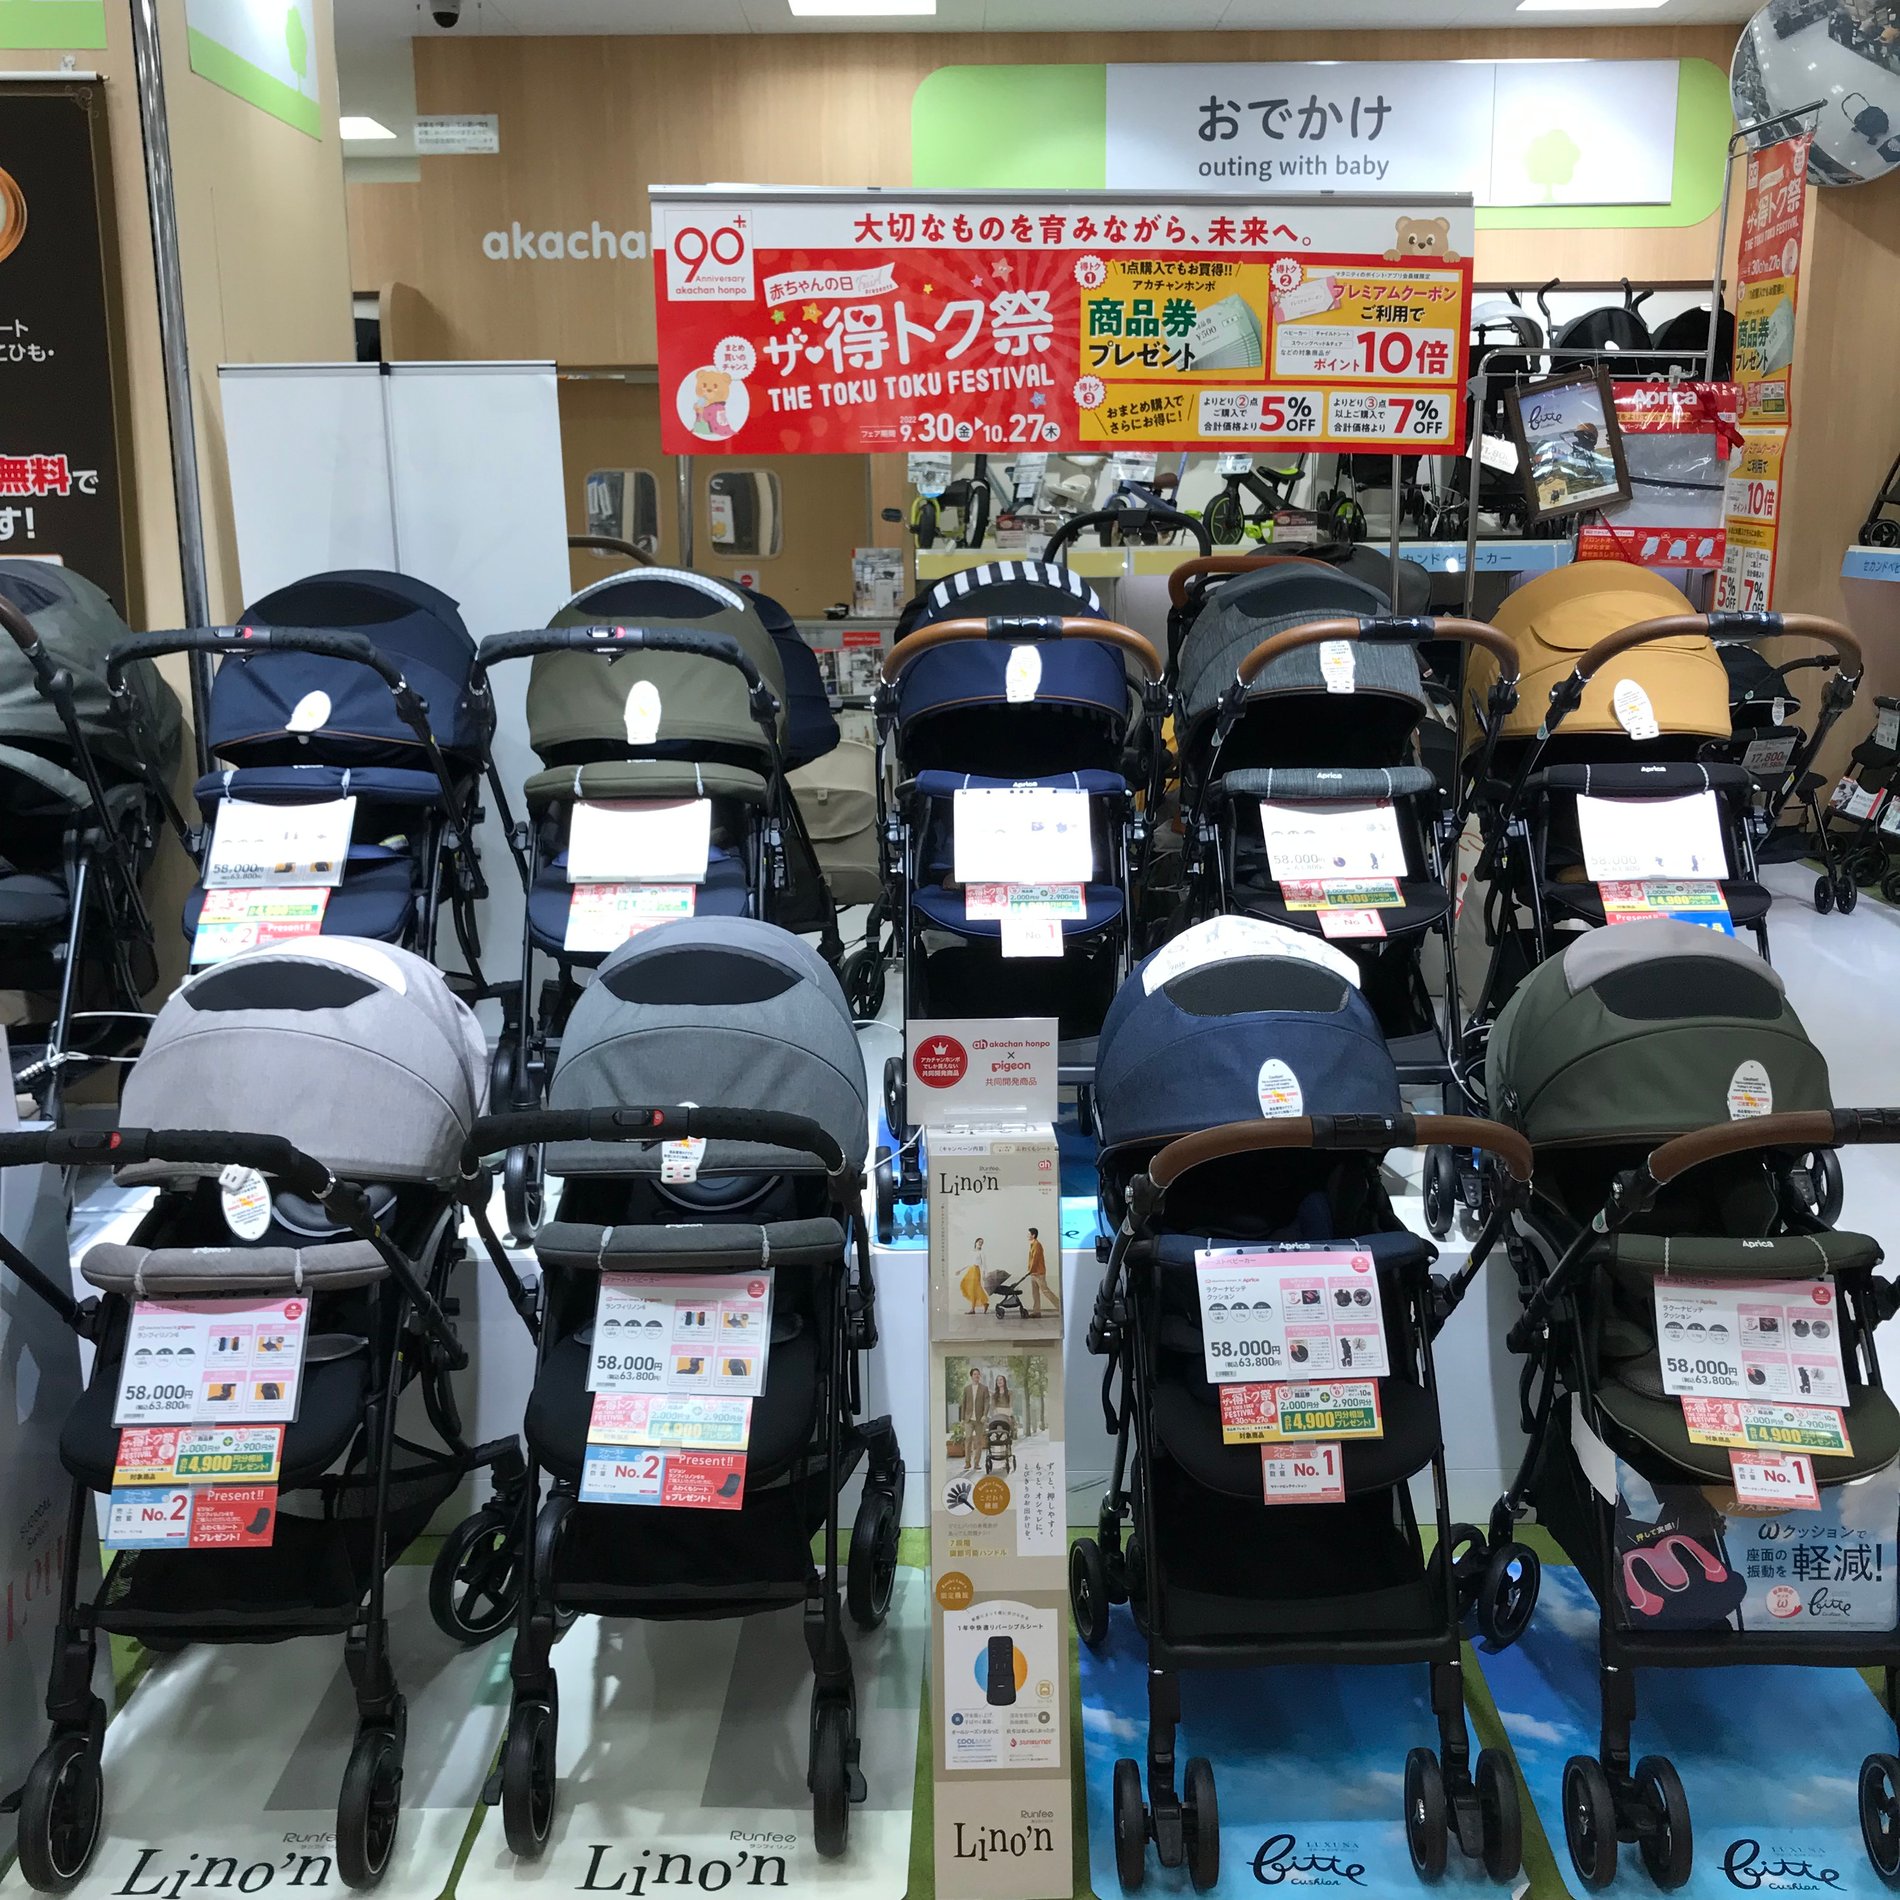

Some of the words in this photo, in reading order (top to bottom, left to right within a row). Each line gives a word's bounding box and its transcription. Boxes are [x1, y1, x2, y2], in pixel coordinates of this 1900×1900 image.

[1198, 95, 1392, 142] おでかけ
[1199, 155, 1273, 182] outing
[1279, 154, 1327, 176] with
[1336, 154, 1390, 181] baby
[854, 213, 1312, 247] 大切なものを育みながら、未来へ。
[482, 220, 648, 260] akacha
[1080, 262, 1101, 271] 得トク
[1120, 262, 1233, 277] 1点購入でもお買得!!
[1276, 264, 1298, 274] 得トク
[695, 275, 745, 284] Anniversary
[769, 276, 854, 301] 赤ちゃんの日
[1132, 280, 1216, 292] アカチャンホンポ
[676, 286, 713, 295] akachan
[717, 286, 747, 297] honpo
[1333, 283, 1457, 302] プレミアムクーポン
[1087, 297, 1198, 338] 商品券
[1361, 305, 1425, 323] ご利用で
[1738, 316, 1769, 348] 商品券
[1089, 340, 1196, 372] プレゼント
[1314, 358, 1360, 372] ポイント
[1357, 331, 1449, 375] 10倍
[768, 388, 812, 412] THE
[819, 382, 877, 405] TOKU
[887, 376, 941, 400] TOKU
[948, 363, 1055, 395] FESTIVAL
[1079, 383, 1100, 392] 得トク
[1106, 395, 1185, 419] おまとめ購入で
[1633, 388, 1698, 408] Aprica
[1213, 408, 1247, 418] ご購入で
[1258, 396, 1312, 432] 5%
[1286, 419, 1316, 432] OFF
[1335, 410, 1385, 420] 以上ご購入で
[1388, 398, 1439, 434] 7%
[1109, 411, 1183, 435] さらにお得に!
[1203, 422, 1257, 432] 合計価格より
[1333, 423, 1386, 433] 合計価格より
[1413, 421, 1443, 434] OFF
[0, 454, 98, 496] 無料で
[1748, 483, 1774, 520] 10倍
[1717, 575, 1736, 607] 5%
[1744, 579, 1763, 612] 7%
[990, 1040, 1023, 1048] akachan
[1025, 1040, 1051, 1049] honpo
[991, 1060, 1032, 1072] pigeon
[985, 1077, 1037, 1086] 共同開発商品
[1279, 1242, 1311, 1250] Aprica
[1743, 1240, 1774, 1248] Aprica
[1210, 1340, 1281, 1358] 58,000円
[597, 1355, 663, 1371] 58,000円
[1667, 1357, 1738, 1376] 58,000円
[125, 1385, 193, 1400] 58,000円
[1280, 1400, 1319, 1410] 2,000円分
[1333, 1399, 1372, 1408] 2,900円分
[1225, 1409, 1255, 1419] FESTIVAL
[1293, 1411, 1335, 1430] 4,900
[1336, 1419, 1371, 1427] プレゼント!
[1759, 1427, 1801, 1443] 4,900
[189, 1455, 233, 1472] 4,900
[614, 1455, 661, 1479] No.2
[678, 1455, 734, 1467] Present!!
[1293, 1450, 1334, 1477] No.1
[1764, 1460, 1805, 1484] No.1
[207, 1490, 264, 1501] Present!!
[141, 1495, 188, 1521] No.2
[1746, 1549, 1787, 1562] 座面の
[1792, 1543, 1883, 1582] 軽減!
[1746, 1565, 1786, 1578] 振動を
[1021, 1810, 1053, 1818] Runfee
[283, 1832, 336, 1844] Runfe
[730, 1830, 797, 1843] Runfee
[953, 1823, 1054, 1861] Lino'n
[111, 1848, 332, 1899] Lino'n
[574, 1844, 789, 1896] Lino'n
